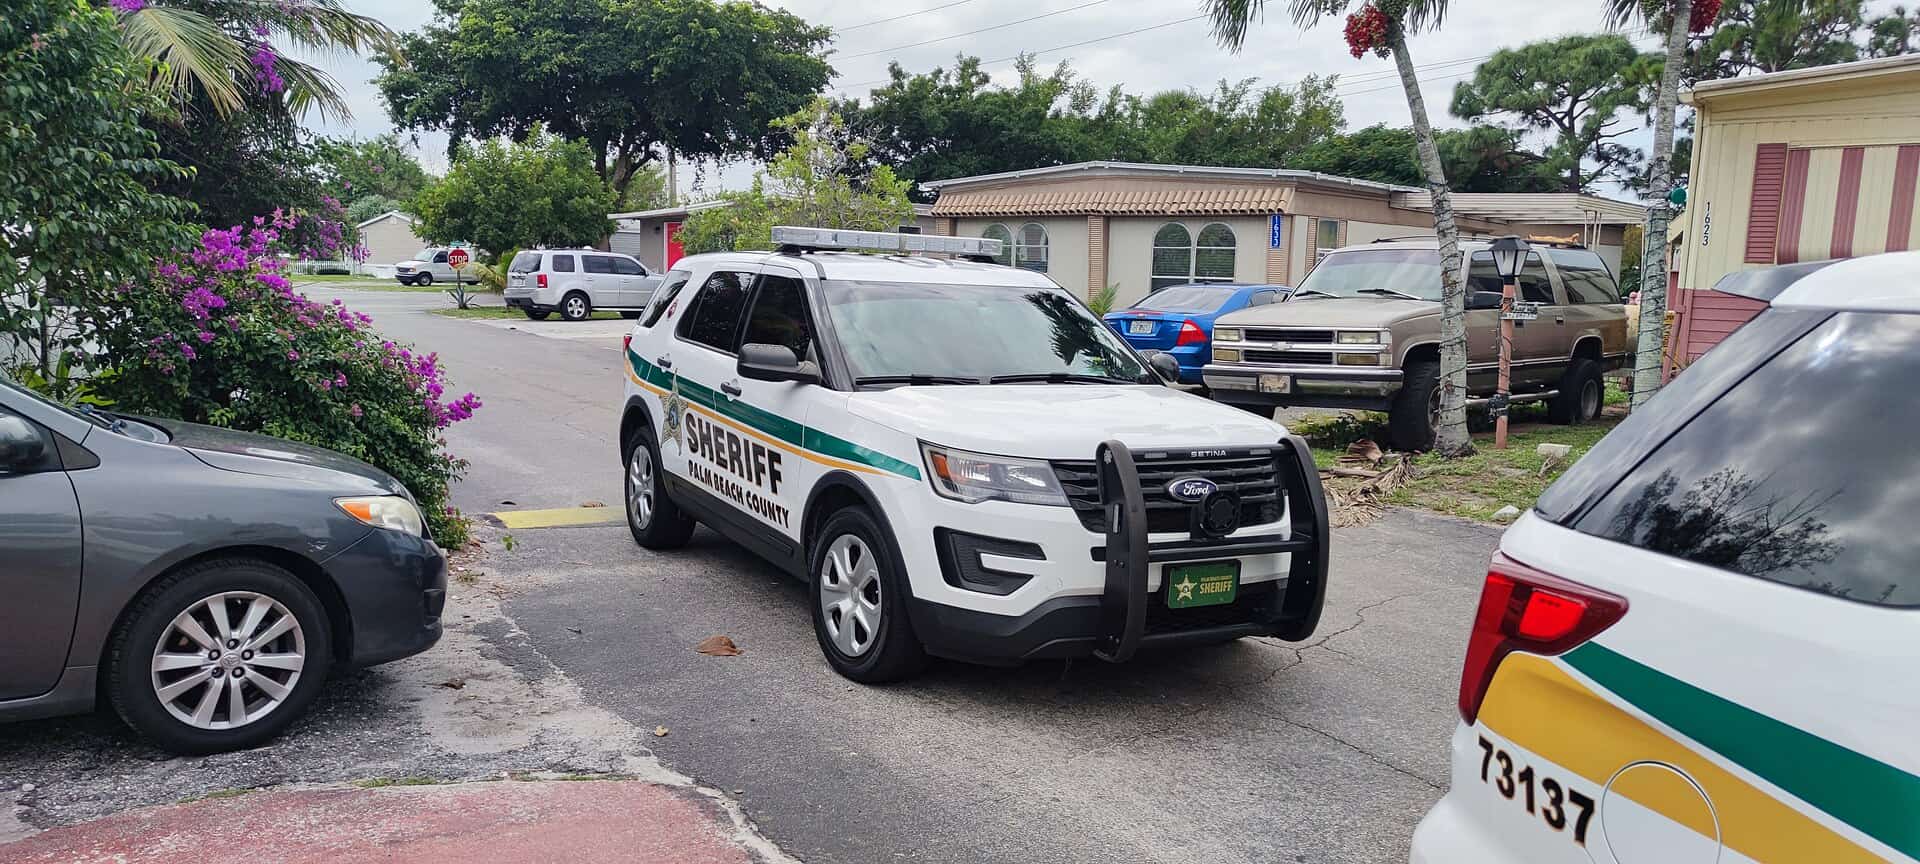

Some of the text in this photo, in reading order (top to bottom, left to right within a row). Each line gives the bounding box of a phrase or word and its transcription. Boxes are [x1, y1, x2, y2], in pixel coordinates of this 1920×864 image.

[1702, 201, 1711, 247] 1623
[449, 255, 468, 264] STOP
[685, 412, 783, 495] SHERIFF
[1191, 450, 1227, 458] SETINA
[688, 459, 790, 529] PALM BEACH COUNTY
[1183, 482, 1209, 496] Ford
[1199, 580, 1233, 594] SHERIFF
[1478, 735, 1596, 848] 73137
